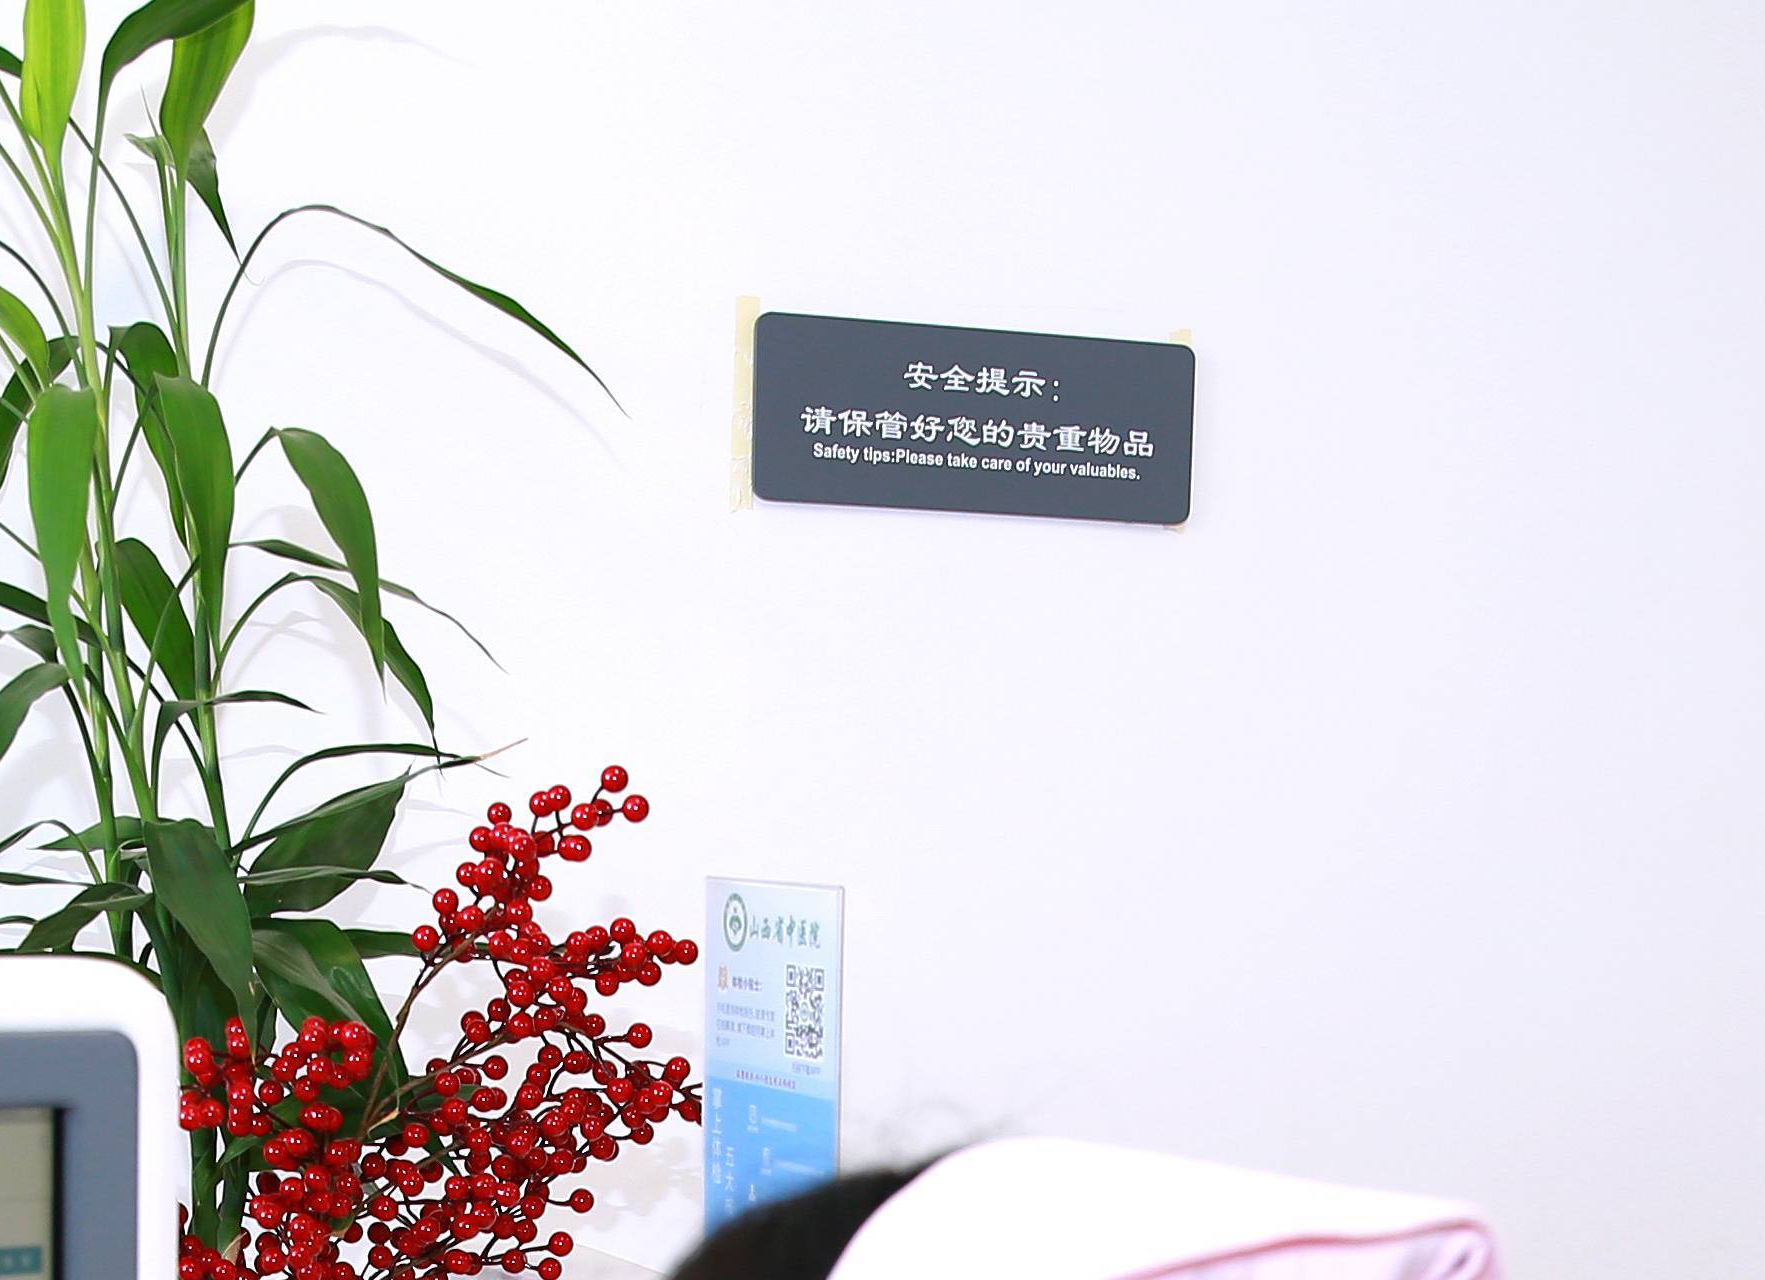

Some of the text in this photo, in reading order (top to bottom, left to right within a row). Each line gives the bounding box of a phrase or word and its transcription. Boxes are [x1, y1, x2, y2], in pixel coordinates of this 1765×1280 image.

[800, 406, 1154, 457] 请保管好您的贵重物品
[813, 442, 860, 464] Safety
[947, 452, 978, 469] take
[981, 457, 1013, 472] care
[1015, 457, 1032, 472] of
[1033, 462, 1068, 477] your
[1069, 461, 1141, 480] valuables.
